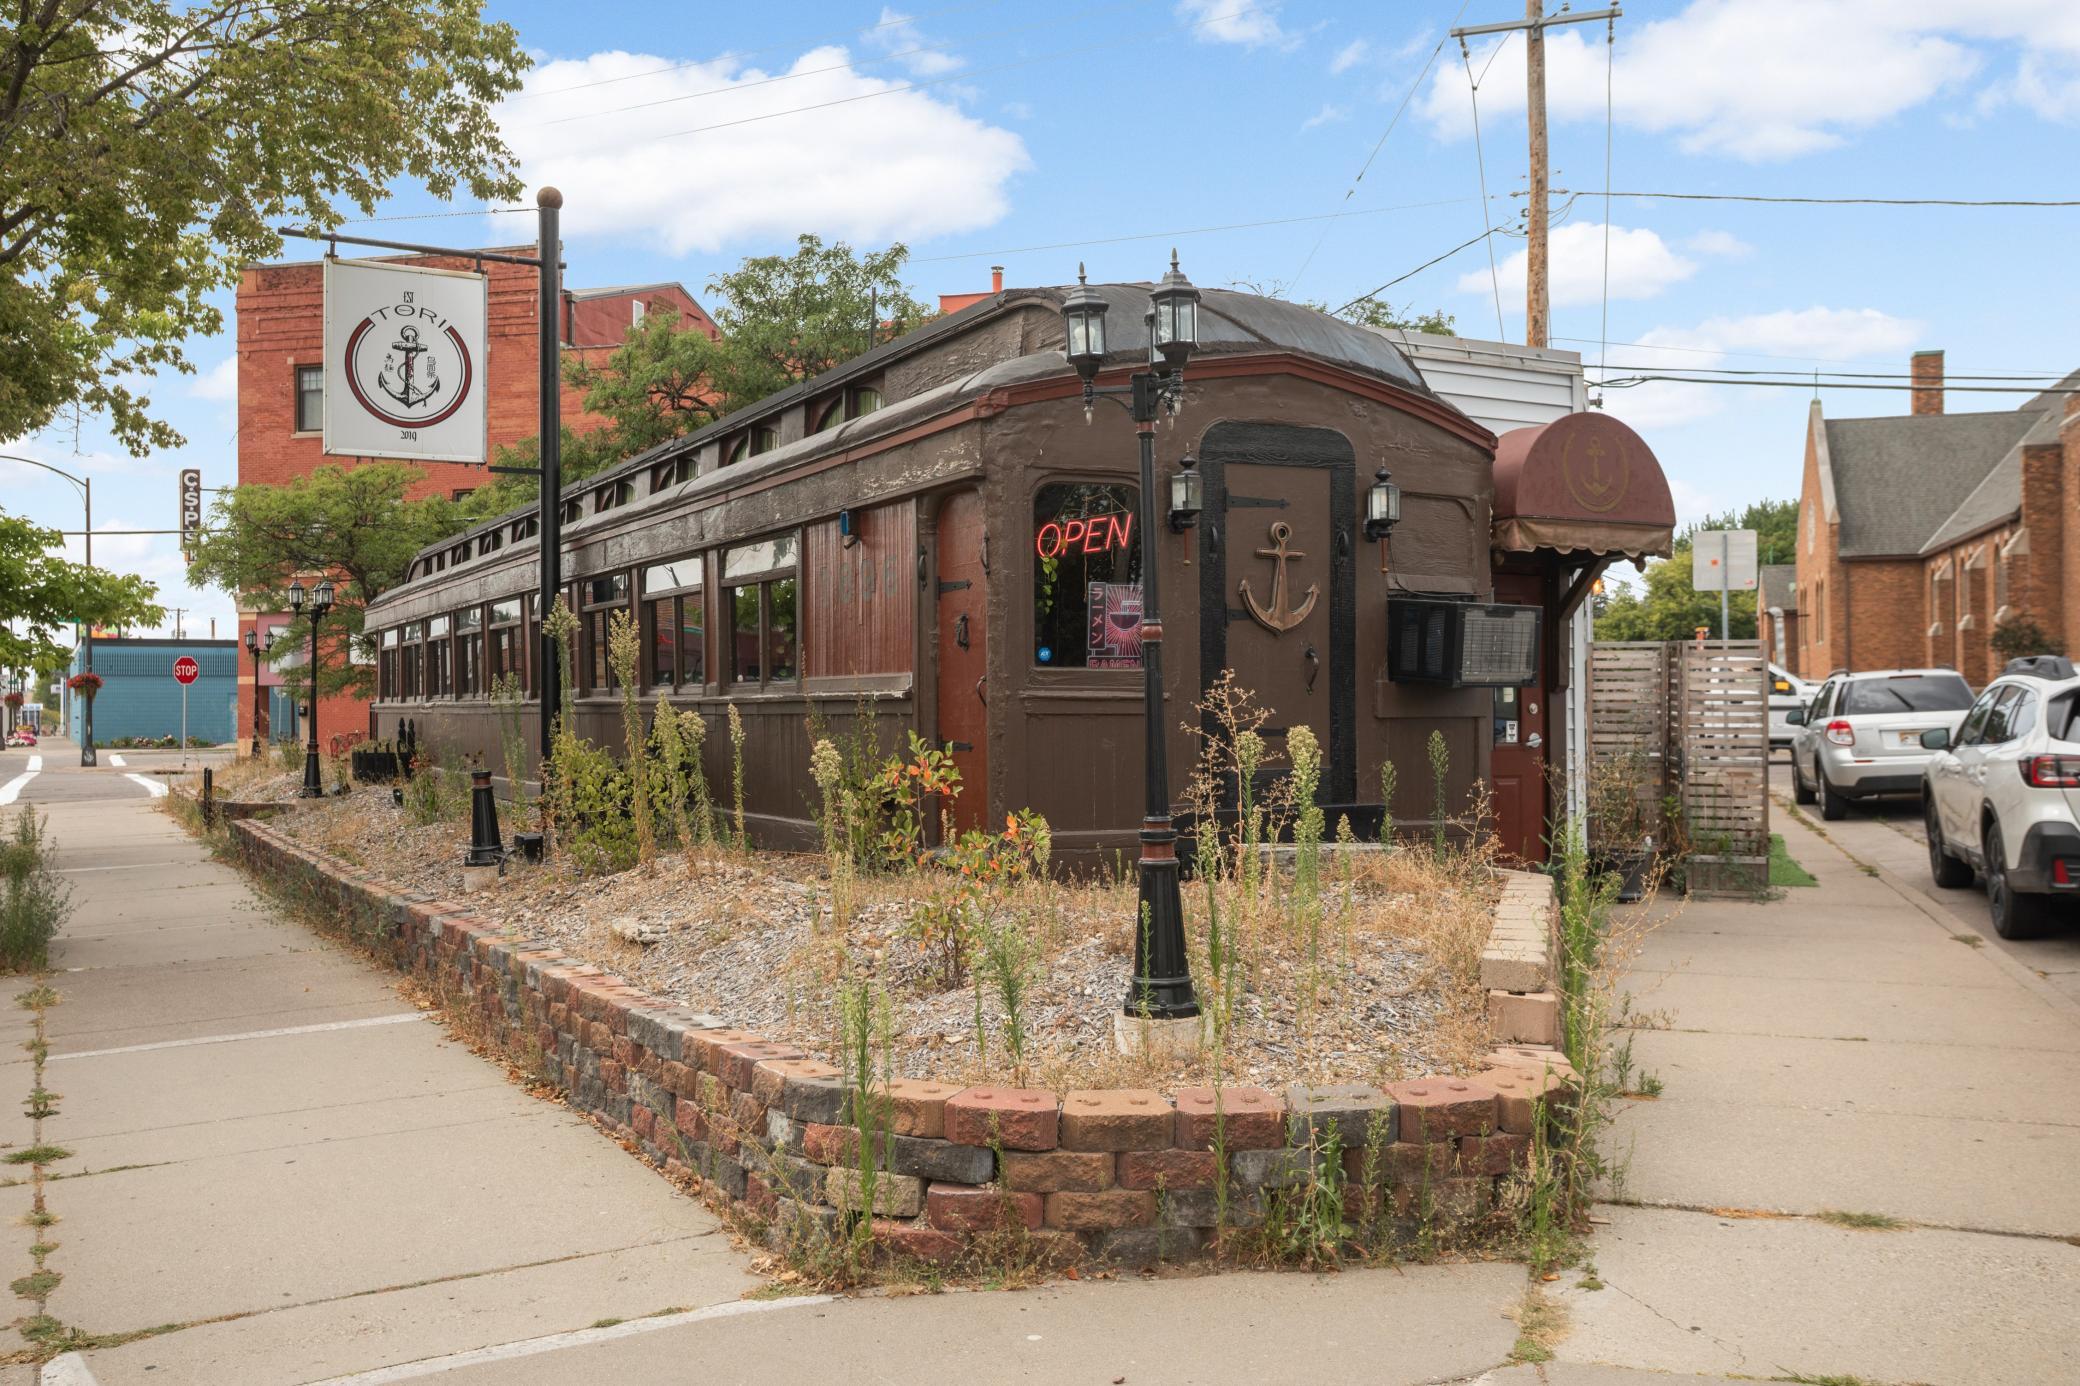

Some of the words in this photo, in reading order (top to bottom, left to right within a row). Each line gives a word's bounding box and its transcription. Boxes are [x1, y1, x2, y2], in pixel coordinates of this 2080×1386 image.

[371, 304, 446, 328] TORI
[400, 430, 417, 442] 2019
[1037, 512, 1133, 558] OPEN
[175, 665, 197, 676] STOP
